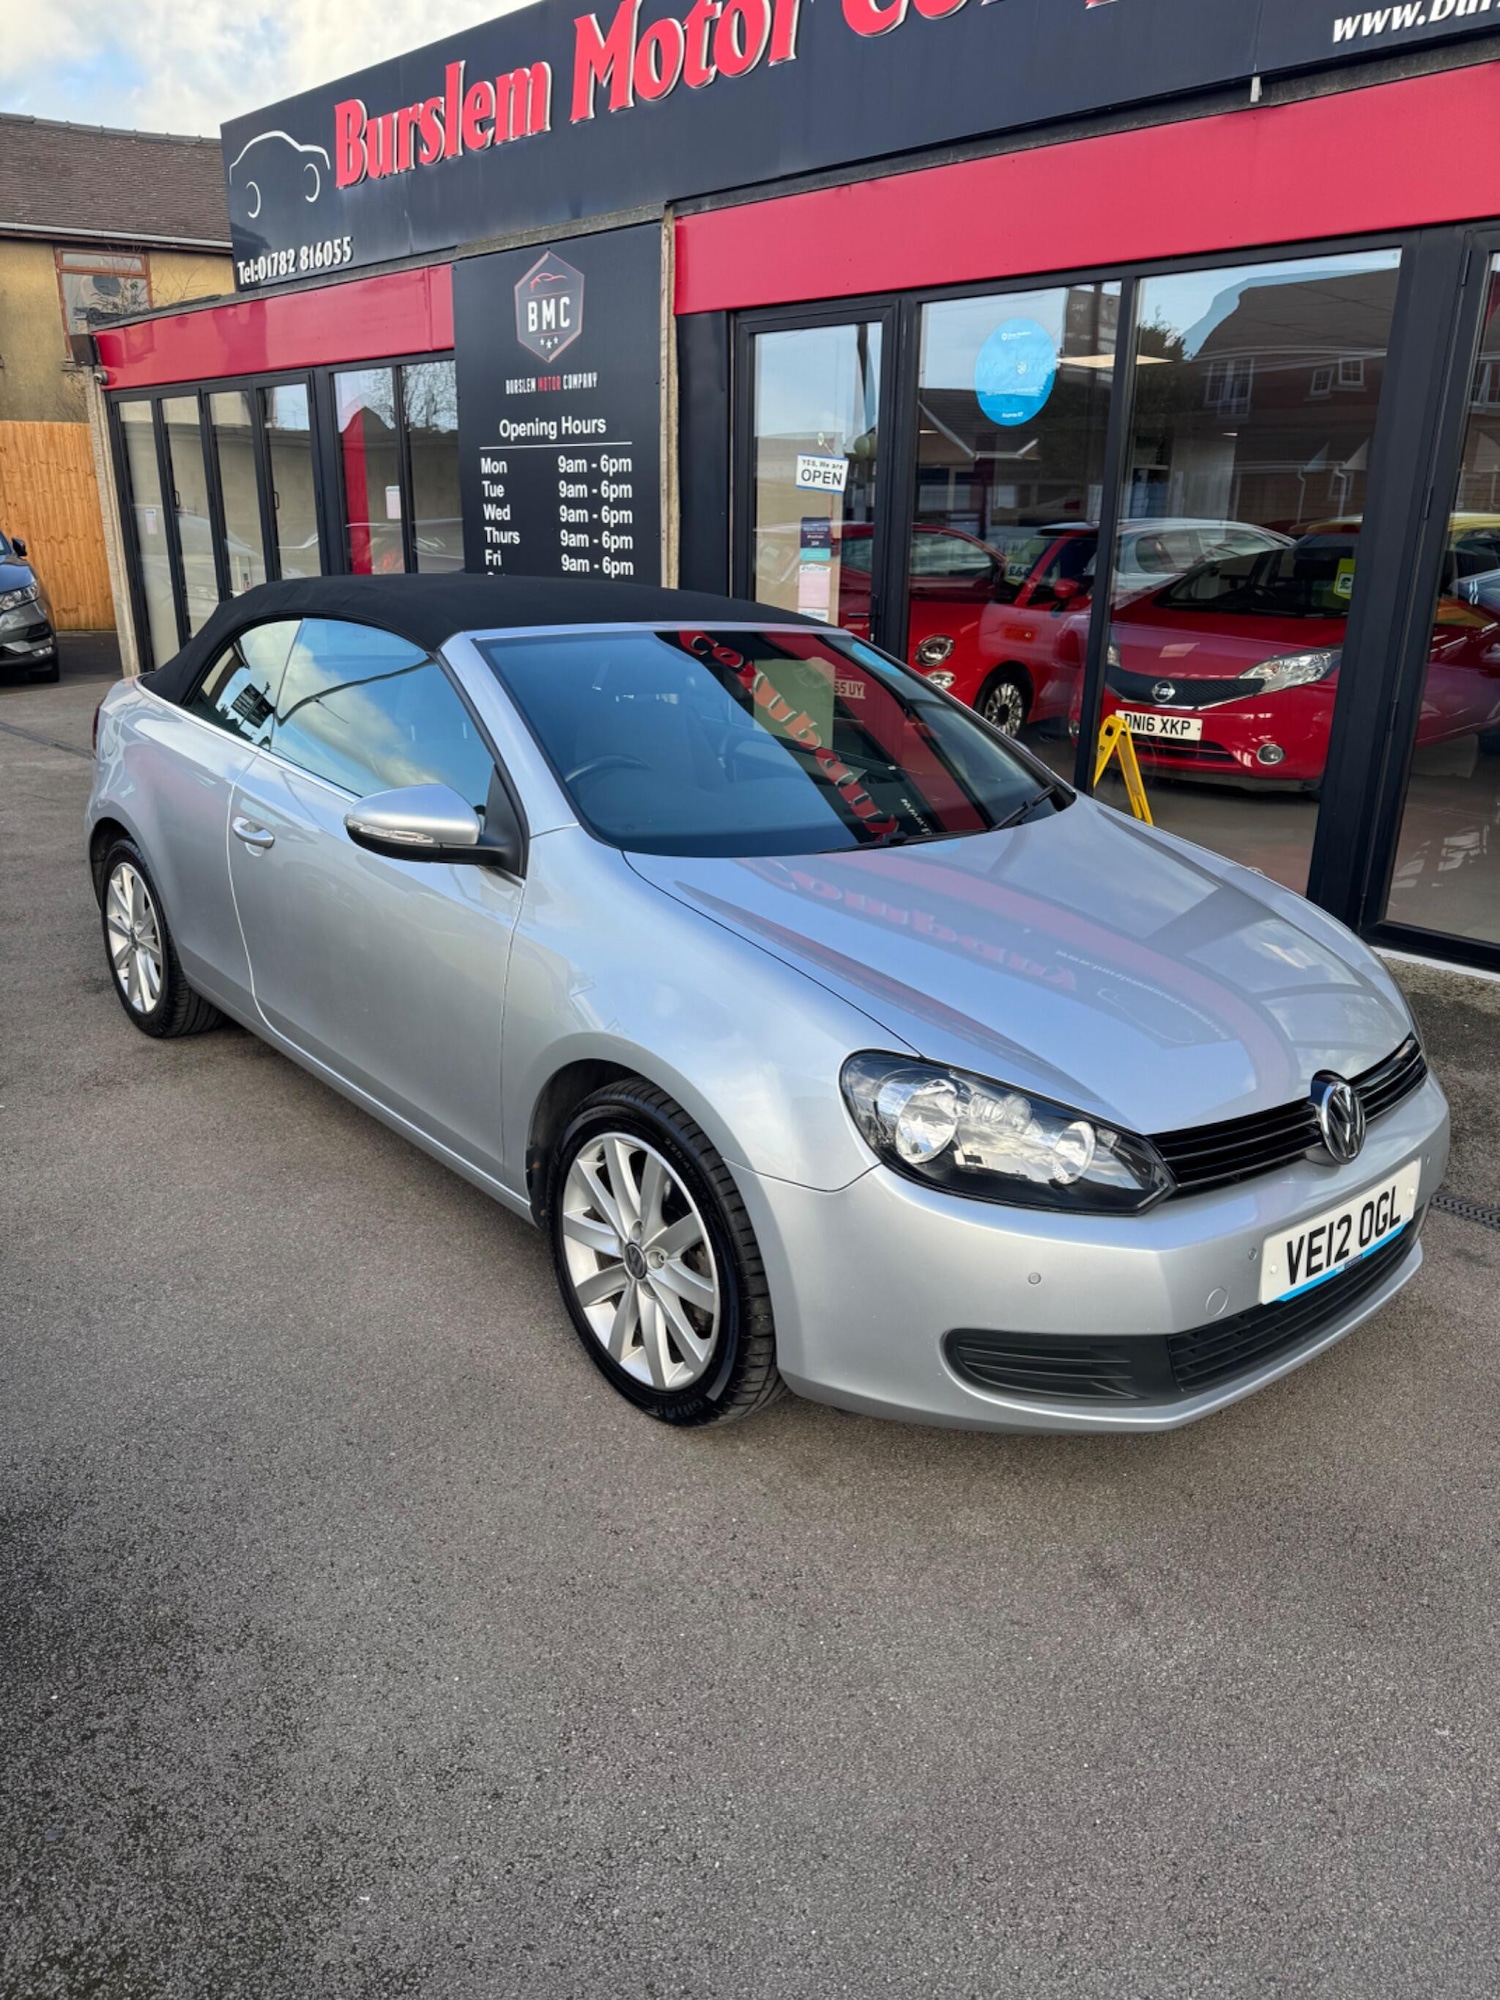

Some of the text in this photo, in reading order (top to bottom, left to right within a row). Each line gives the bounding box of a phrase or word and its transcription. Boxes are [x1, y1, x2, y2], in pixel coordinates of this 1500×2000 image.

[334, 0, 798, 189] Burslem Motor
[237, 236, 353, 285] Tel:01782 816055
[527, 297, 571, 332] BMC
[506, 372, 597, 395] BURSLEM MOTOR COMPANY
[499, 416, 606, 441] Opening Hours
[480, 457, 508, 475] Mon
[557, 455, 588, 474] 9am
[600, 454, 633, 477] 6pm
[801, 468, 843, 486] OPEN
[481, 481, 505, 498] Tue
[558, 480, 589, 498] 9am
[600, 480, 633, 502] 6pm
[483, 504, 511, 521] Wed
[559, 505, 590, 523] 9am
[601, 505, 633, 528] 6pm
[484, 527, 521, 545] Thurs
[559, 529, 591, 548] 9am
[602, 530, 634, 554] 6pm
[485, 549, 502, 566] Fri
[560, 553, 590, 573] 9am
[602, 555, 635, 579] 6pm
[1124, 713, 1191, 736] DN16 XKP
[1286, 1185, 1402, 1286] VE12 OGL
